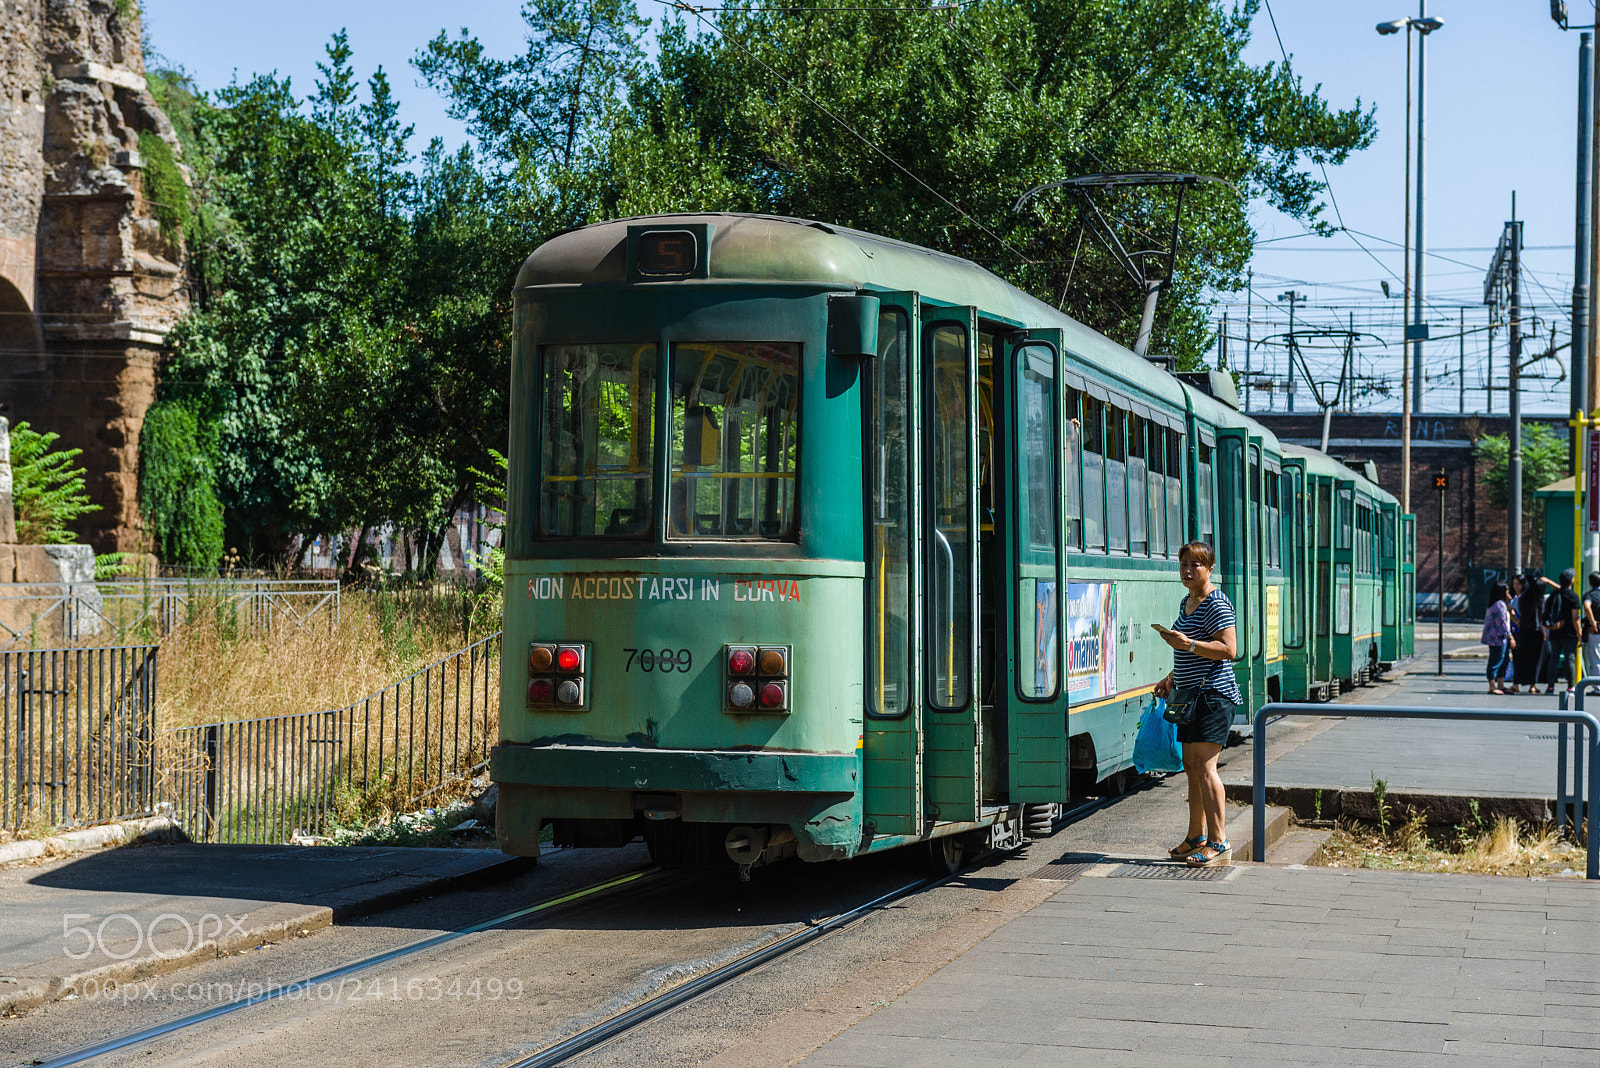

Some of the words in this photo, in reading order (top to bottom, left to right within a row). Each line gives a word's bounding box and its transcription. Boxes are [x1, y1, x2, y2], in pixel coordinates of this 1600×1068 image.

[658, 240, 682, 270] 5
[528, 577, 563, 600] NON
[571, 577, 694, 601] ACCOSTARSI
[701, 579, 720, 601] IN
[734, 579, 801, 602] CURVA
[623, 648, 693, 674] 7089
